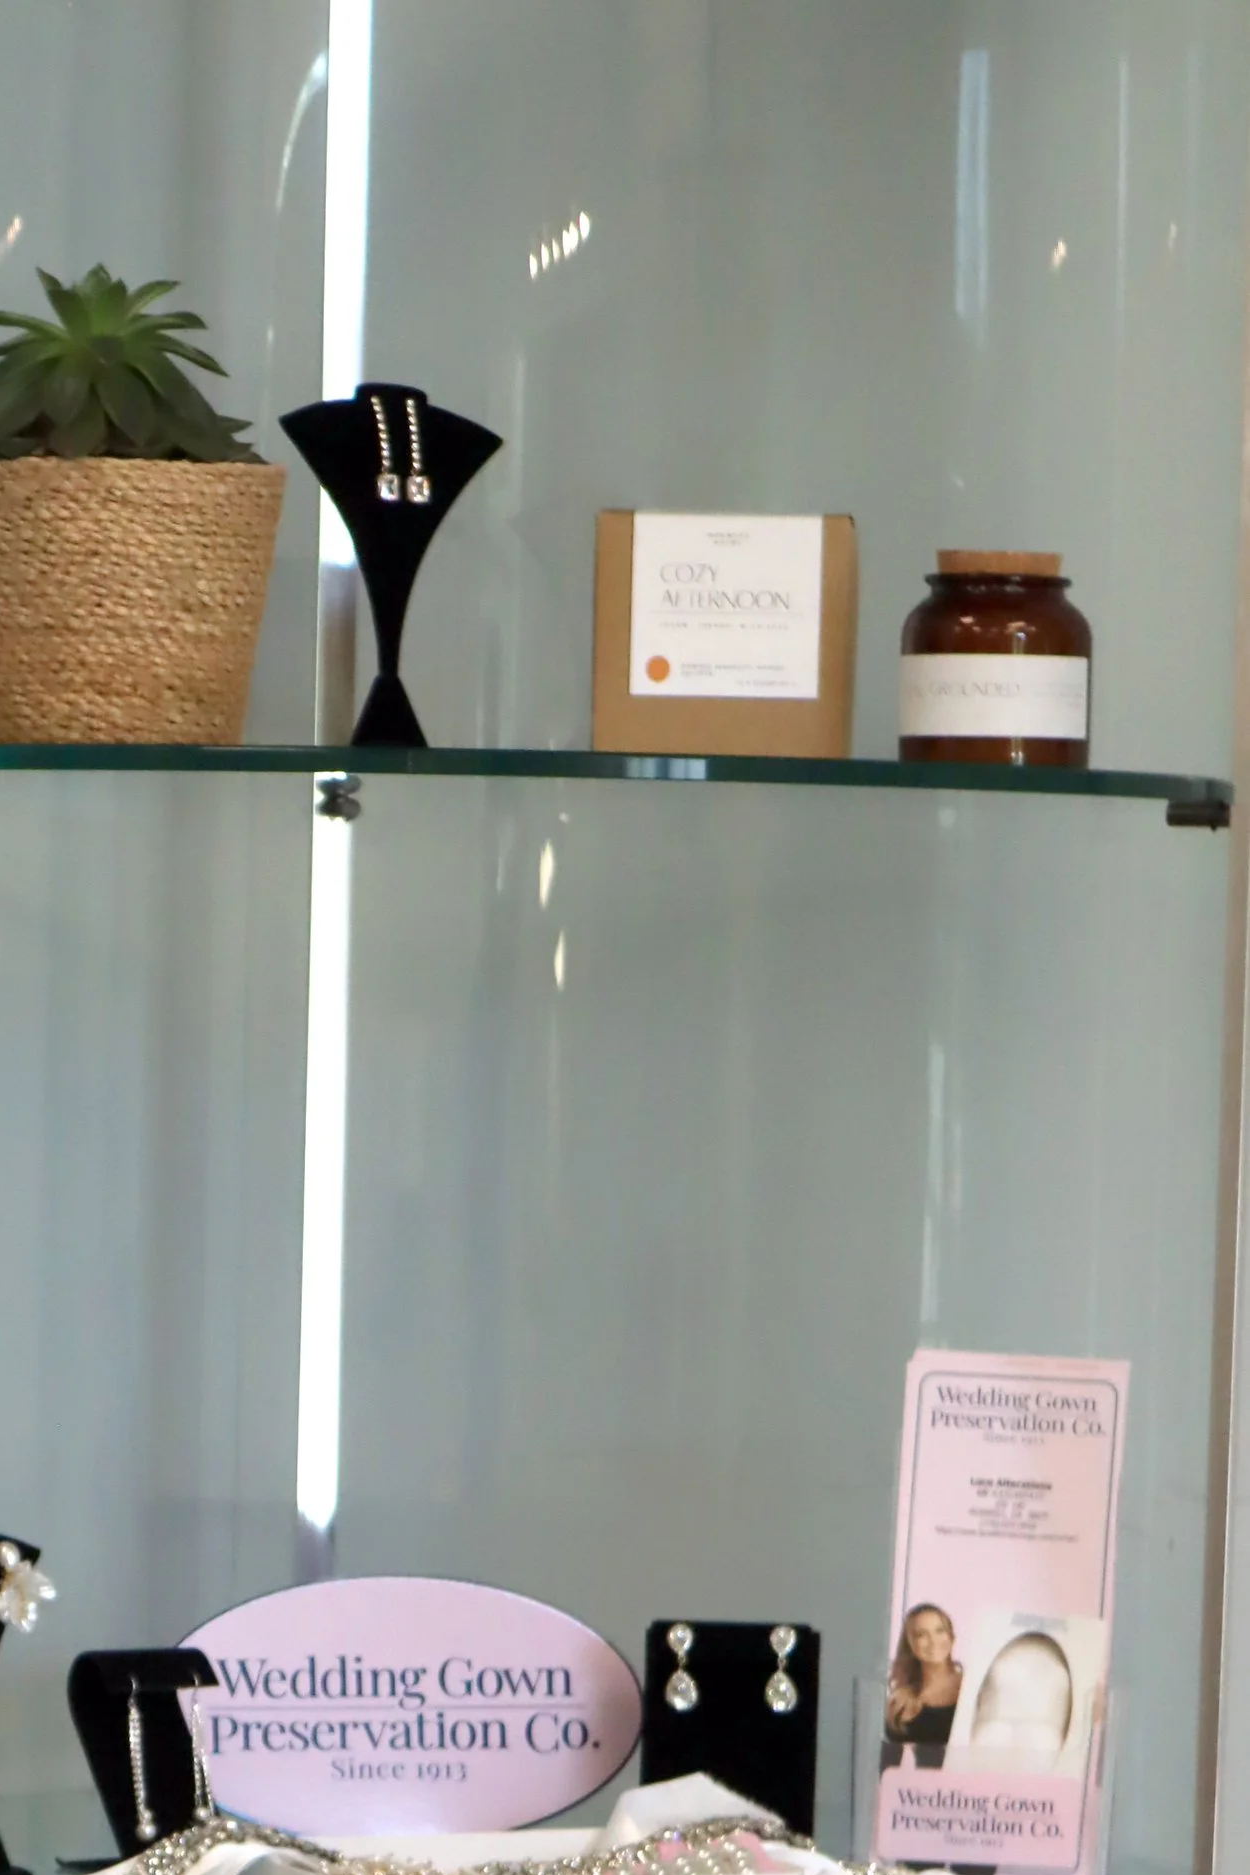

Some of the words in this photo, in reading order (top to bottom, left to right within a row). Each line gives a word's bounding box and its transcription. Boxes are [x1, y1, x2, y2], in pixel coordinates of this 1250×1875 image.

[660, 562, 718, 584] COZY
[660, 588, 791, 611] AFTERNOON
[937, 1384, 1031, 1412] Wedding
[1035, 1391, 1097, 1412] Gown
[930, 1409, 1065, 1434] Preservation
[1071, 1416, 1107, 1437] Co.
[216, 1654, 427, 1708] Wedding
[437, 1656, 573, 1698] Gown
[209, 1711, 510, 1755] Preservation
[524, 1711, 602, 1755] Co.
[330, 1757, 406, 1780] Since
[416, 1760, 468, 1783] 1913
[897, 1788, 990, 1815] Wedding
[993, 1793, 1055, 1816] Gown
[891, 1809, 1023, 1836] Preservation
[1029, 1820, 1065, 1839] Co.
